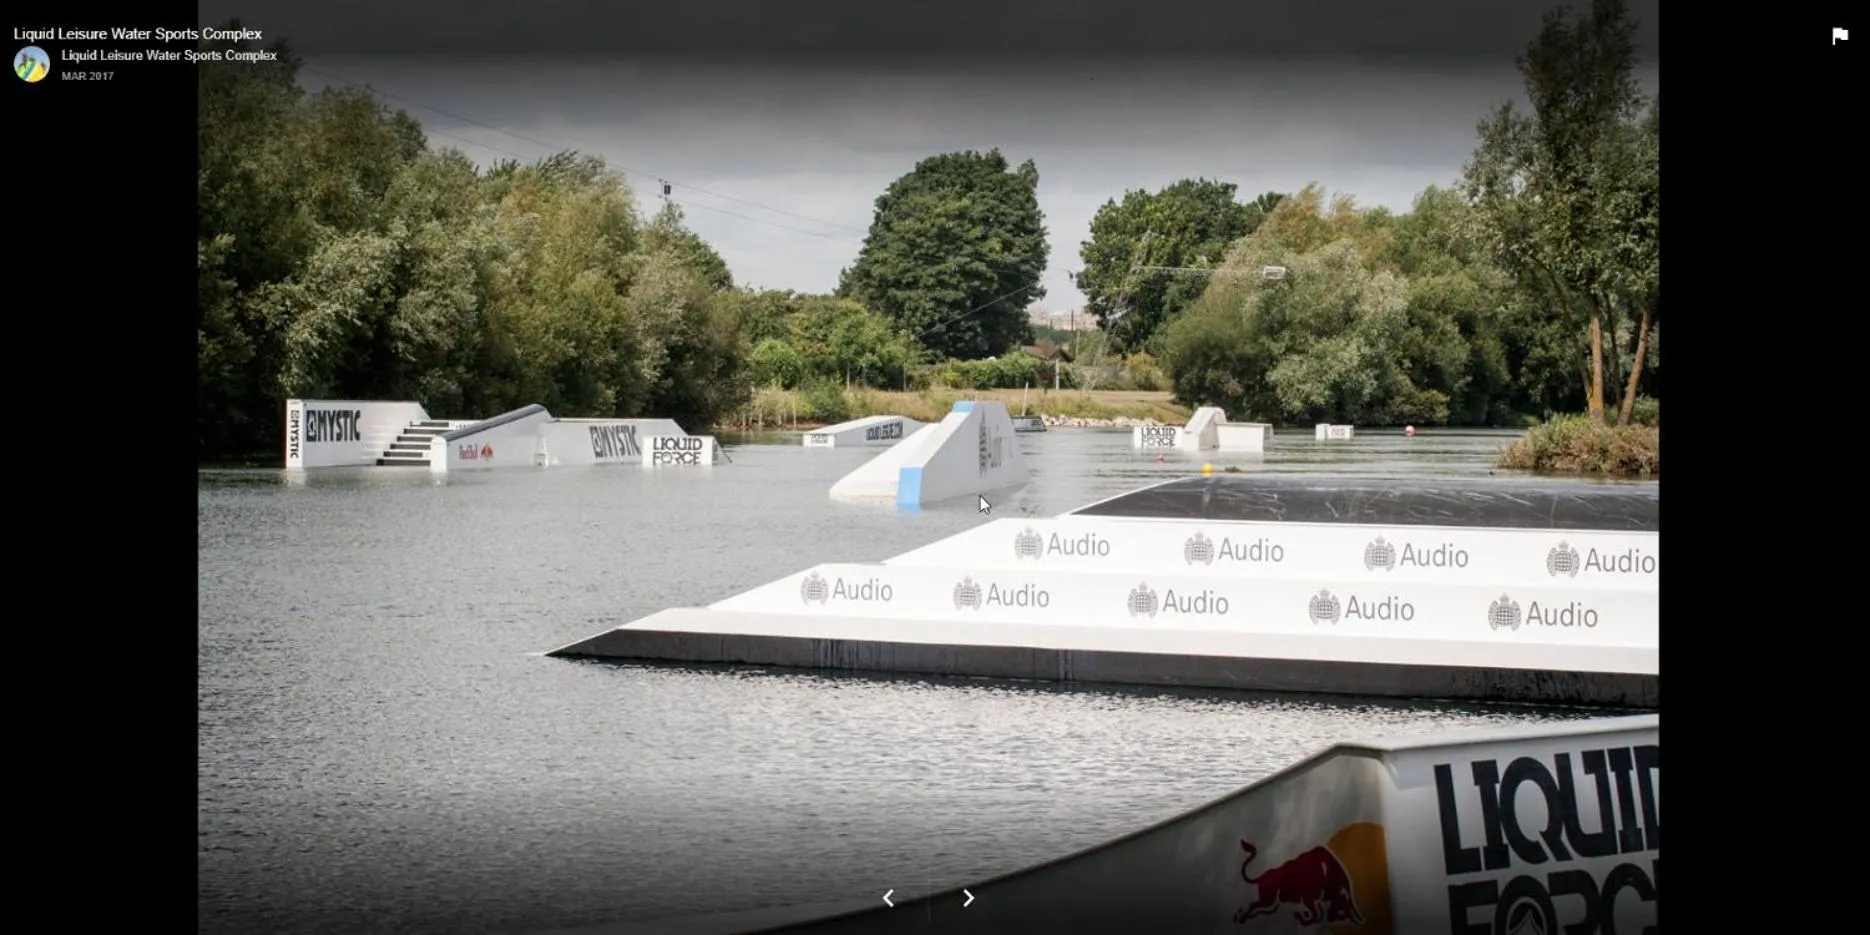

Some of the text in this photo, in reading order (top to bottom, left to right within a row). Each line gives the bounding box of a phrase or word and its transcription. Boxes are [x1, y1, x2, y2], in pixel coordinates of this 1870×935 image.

[317, 409, 361, 442] MYSTIC
[290, 419, 300, 459] MYSTIC
[599, 425, 642, 458] MYSTIC
[652, 436, 703, 451] LIQUID
[652, 451, 701, 465] FORCE
[1046, 532, 1110, 558] Audio
[1218, 537, 1284, 563] Audio
[1399, 542, 1469, 568] Audio
[1583, 547, 1656, 574] Audio
[832, 577, 893, 602] Audio
[985, 583, 1050, 608] Audio
[1162, 589, 1229, 615] Audio
[1344, 595, 1415, 621] Audio
[1525, 601, 1599, 628] Audio
